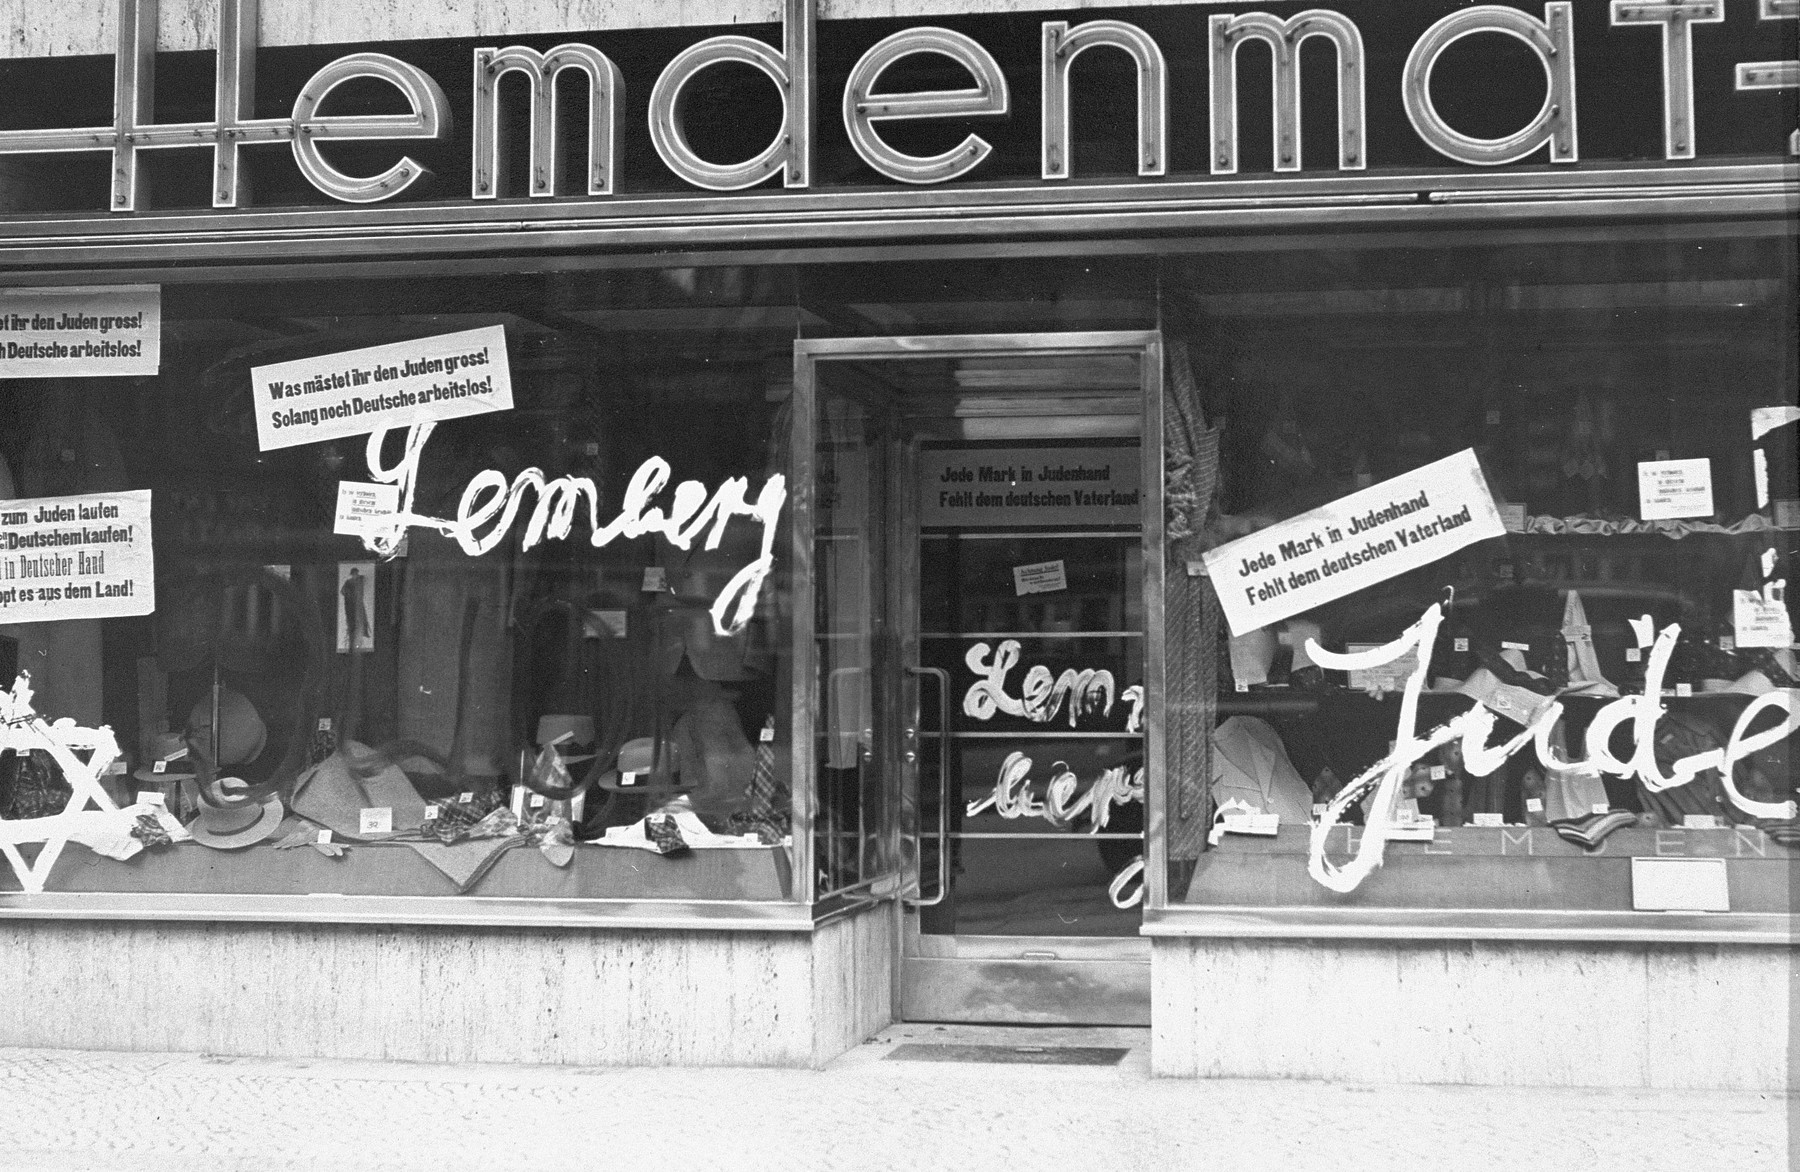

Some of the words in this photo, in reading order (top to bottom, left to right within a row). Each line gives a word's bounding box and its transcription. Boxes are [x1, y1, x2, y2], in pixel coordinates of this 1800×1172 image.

[11, 314, 30, 331] ihr
[31, 313, 55, 331] den
[56, 312, 98, 330] Juden
[100, 311, 143, 334] gross!
[7, 341, 68, 359] Deutsche
[69, 340, 141, 358] arbeitslos!
[269, 381, 301, 400] Was
[303, 372, 351, 395] mästet
[352, 368, 371, 387] ihr
[373, 364, 398, 382] den
[400, 357, 443, 378] Juden
[444, 347, 489, 375] gross!
[272, 407, 318, 428] Solang
[320, 401, 351, 421] noch
[352, 389, 416, 415] Deutsche
[418, 376, 492, 404] arbeitslos!
[979, 466, 1016, 482] Mark
[1021, 466, 1033, 482] in
[1038, 465, 1110, 482] Judenhand
[939, 491, 974, 508] Fehlt
[976, 491, 1003, 507] dem
[1006, 490, 1071, 507] deutschen
[1073, 488, 1139, 506] Vaterland
[1, 511, 28, 525] zum
[34, 505, 75, 523] Juden
[78, 502, 119, 520] laufen
[1238, 551, 1276, 577] Jede
[1278, 531, 1324, 562] Mark
[1325, 526, 1343, 545] in
[1347, 490, 1429, 536] Judenhand
[4, 557, 15, 579] in
[20, 552, 73, 578] Deutscher
[78, 550, 105, 575] Hand
[1245, 578, 1288, 605] Fehlt
[1289, 566, 1321, 590] dem
[1321, 540, 1397, 577] deutschen
[1395, 504, 1472, 547] Vaterland
[19, 589, 34, 602] es
[38, 587, 61, 600] aus
[64, 582, 92, 599] dem
[95, 579, 133, 598] Land!
